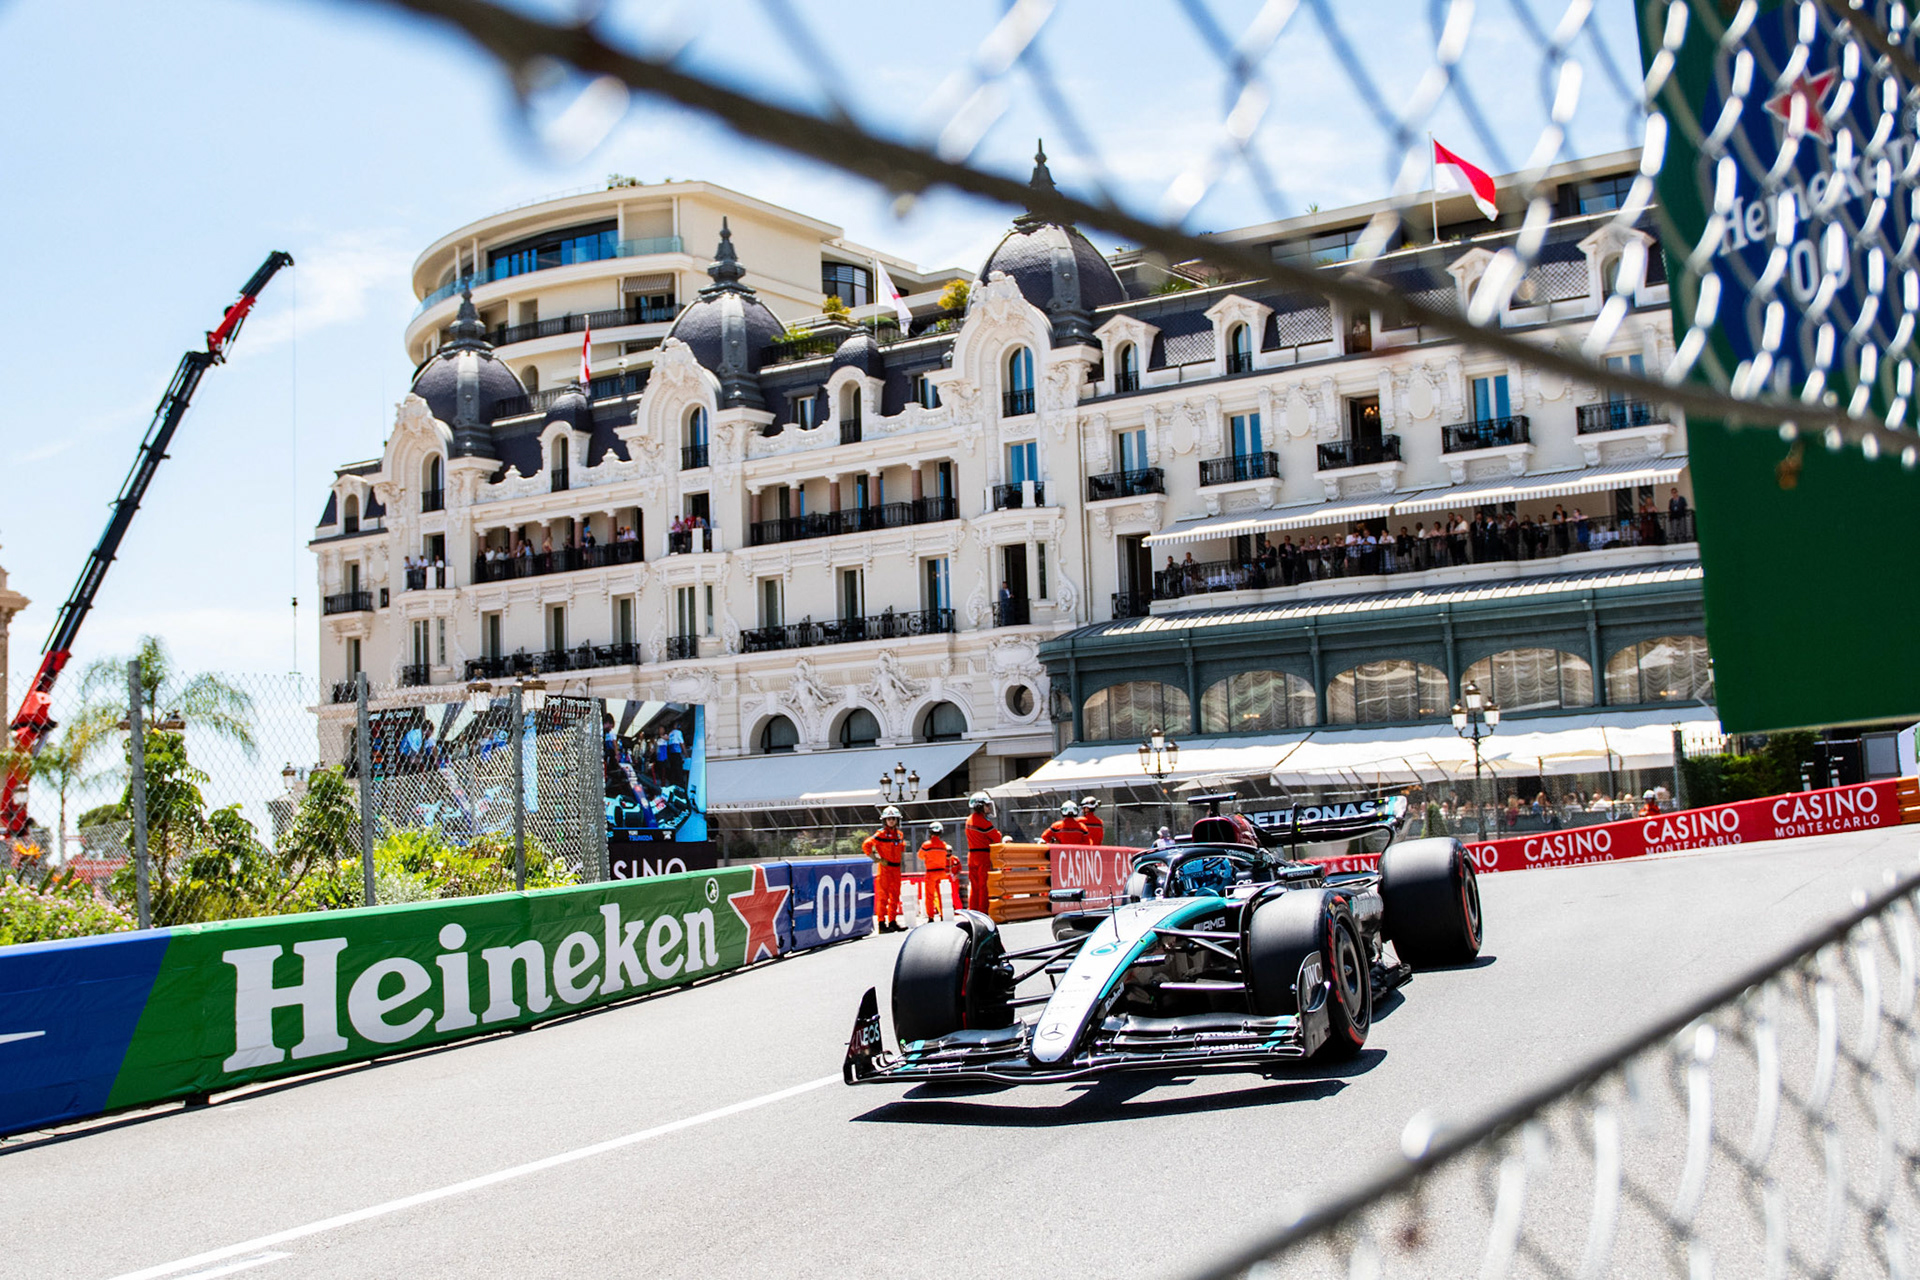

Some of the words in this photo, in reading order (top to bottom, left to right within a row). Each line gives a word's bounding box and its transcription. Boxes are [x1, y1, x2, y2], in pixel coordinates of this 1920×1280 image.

[1244, 801, 1376, 826] ETONAS
[1772, 787, 1878, 824] CASINO
[1643, 808, 1740, 845] CASINO
[1775, 820, 1824, 838] MONTE
[1832, 813, 1881, 831] CARLO
[1524, 829, 1612, 862] CASINO
[1058, 850, 1103, 888] CASINO
[1322, 857, 1375, 873] ASIN
[816, 872, 856, 940] 0.0
[1203, 917, 1226, 931] AMG
[222, 902, 720, 1073] Heineken
[1303, 962, 1323, 990] IWC
